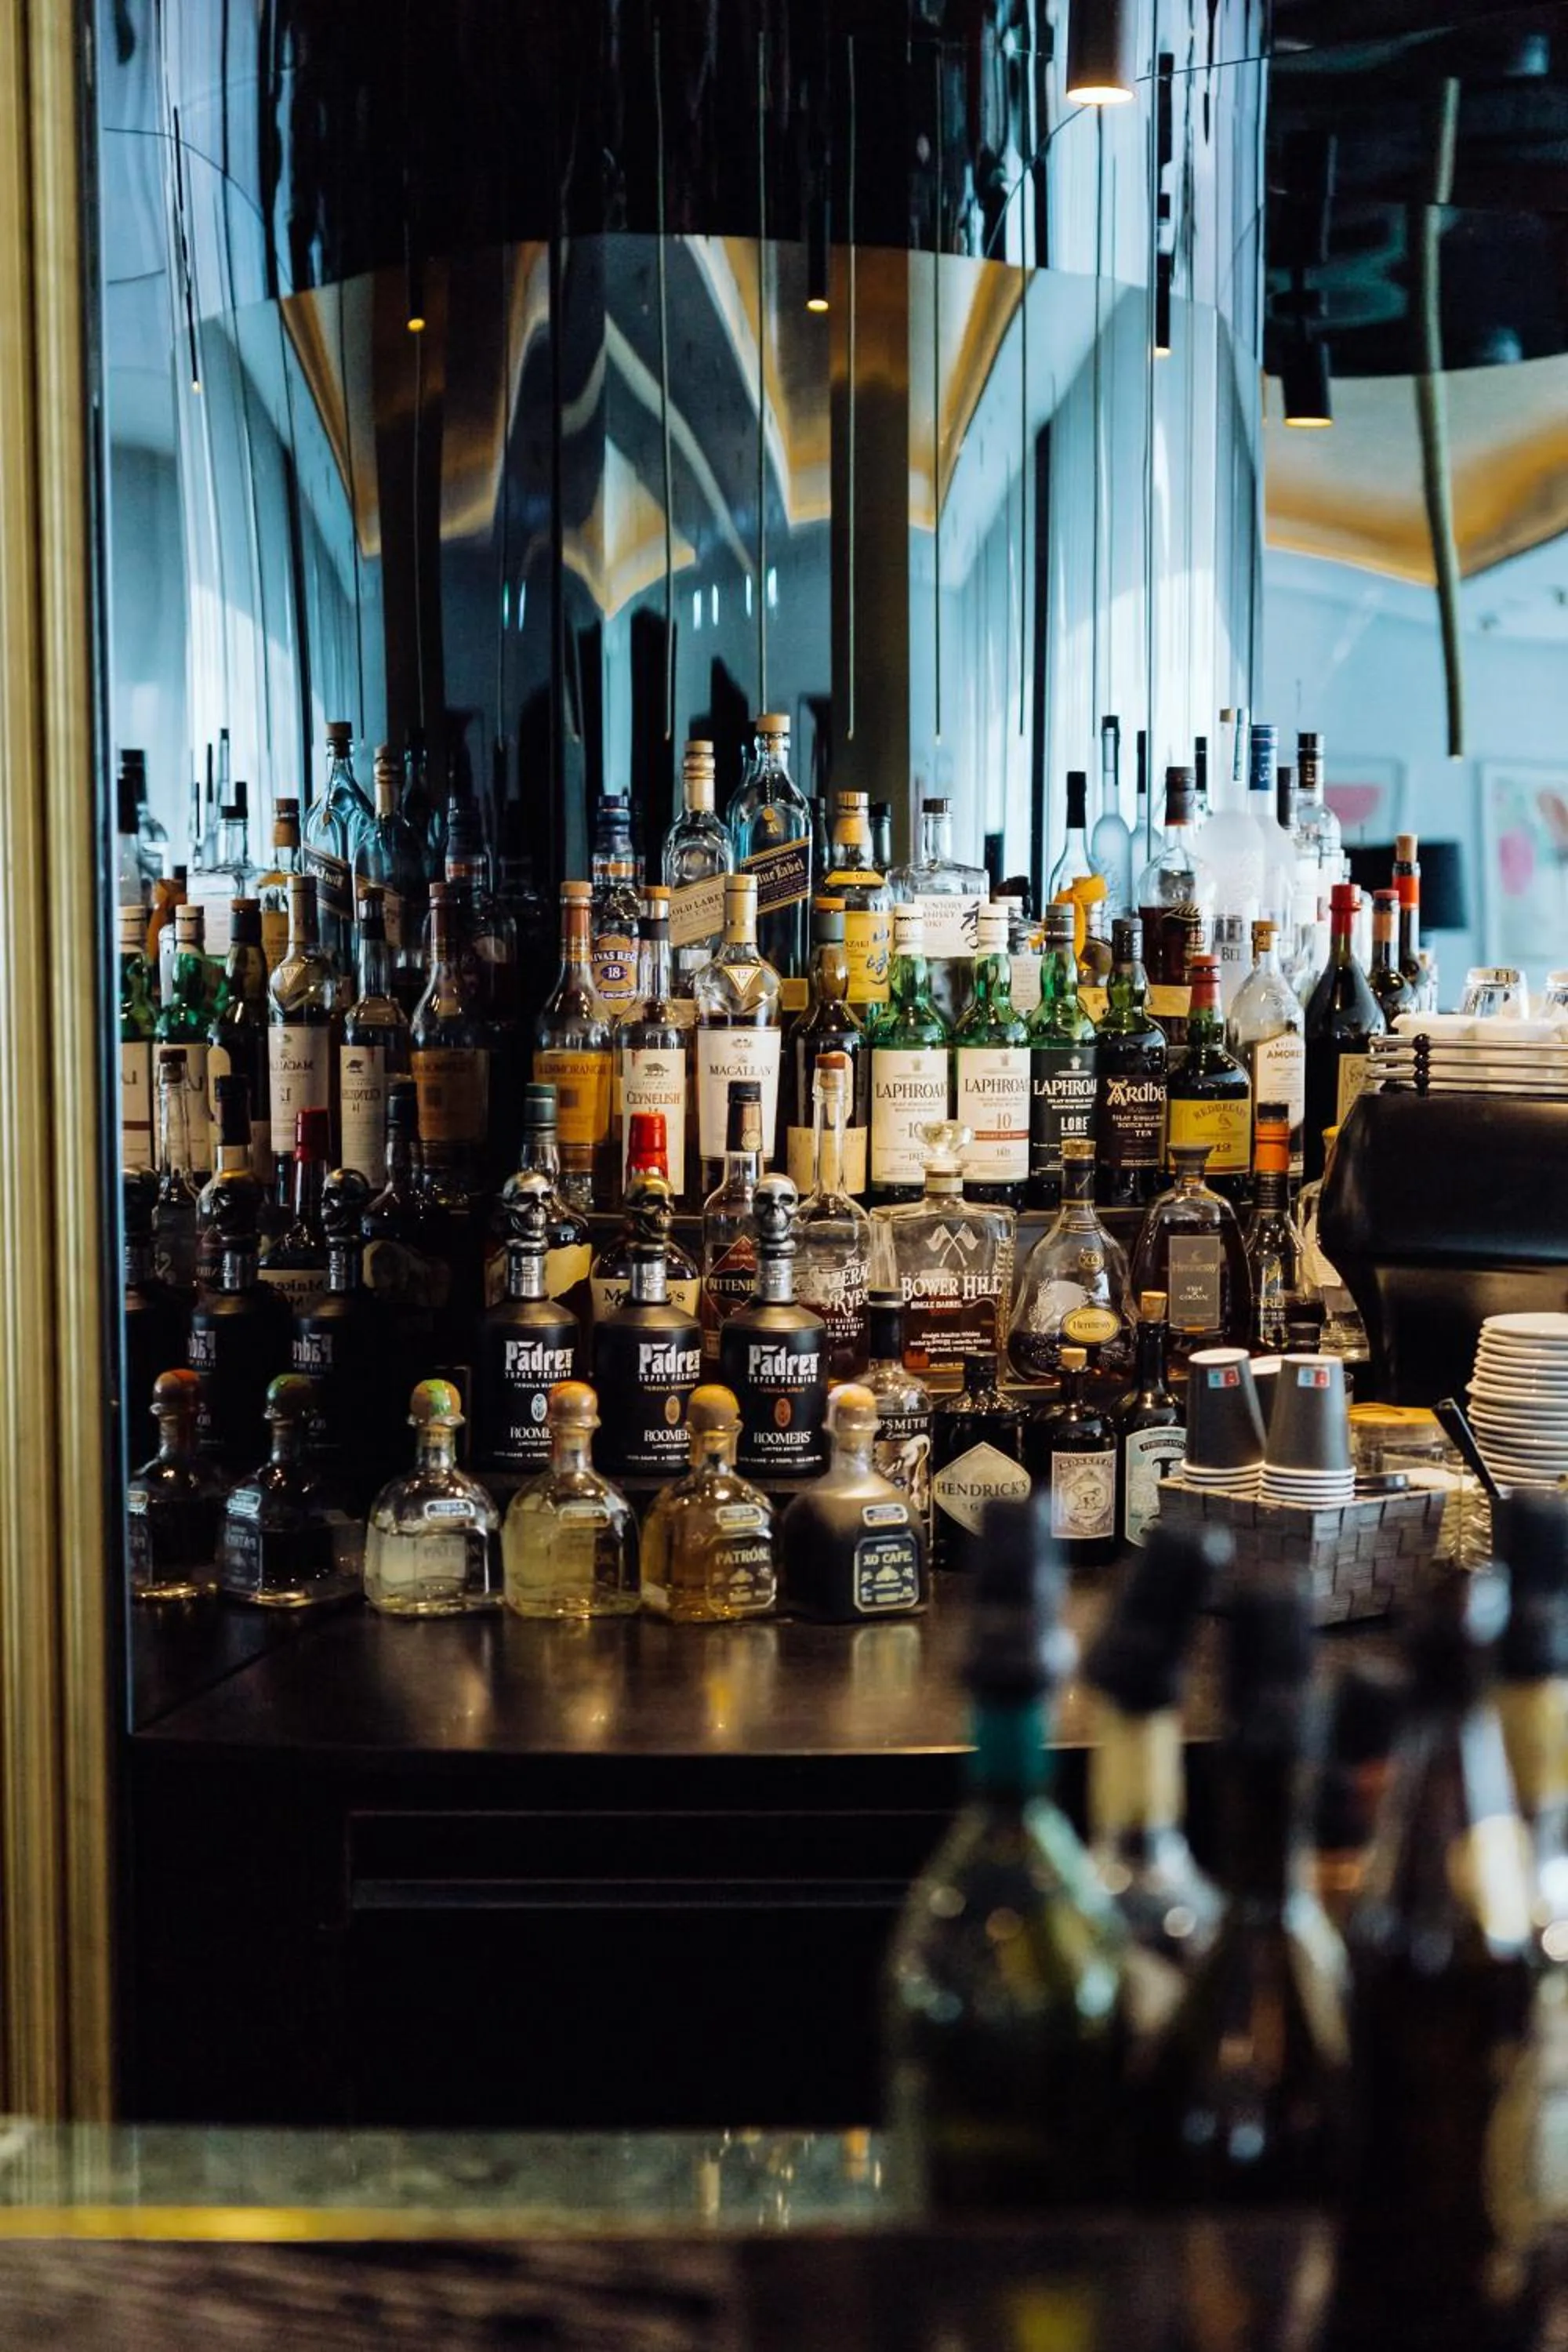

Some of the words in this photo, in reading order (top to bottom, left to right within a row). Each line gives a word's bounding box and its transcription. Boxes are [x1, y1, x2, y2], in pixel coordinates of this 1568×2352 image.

[606, 965, 621, 979] 18
[709, 1065, 773, 1076] MACALLAN
[996, 1112, 1012, 1130] 10
[1060, 1116, 1091, 1131] LORE
[901, 1277, 959, 1301] BOWER
[878, 1417, 929, 1430] PSMITH
[936, 1480, 1027, 1497] HENDRICK'S
